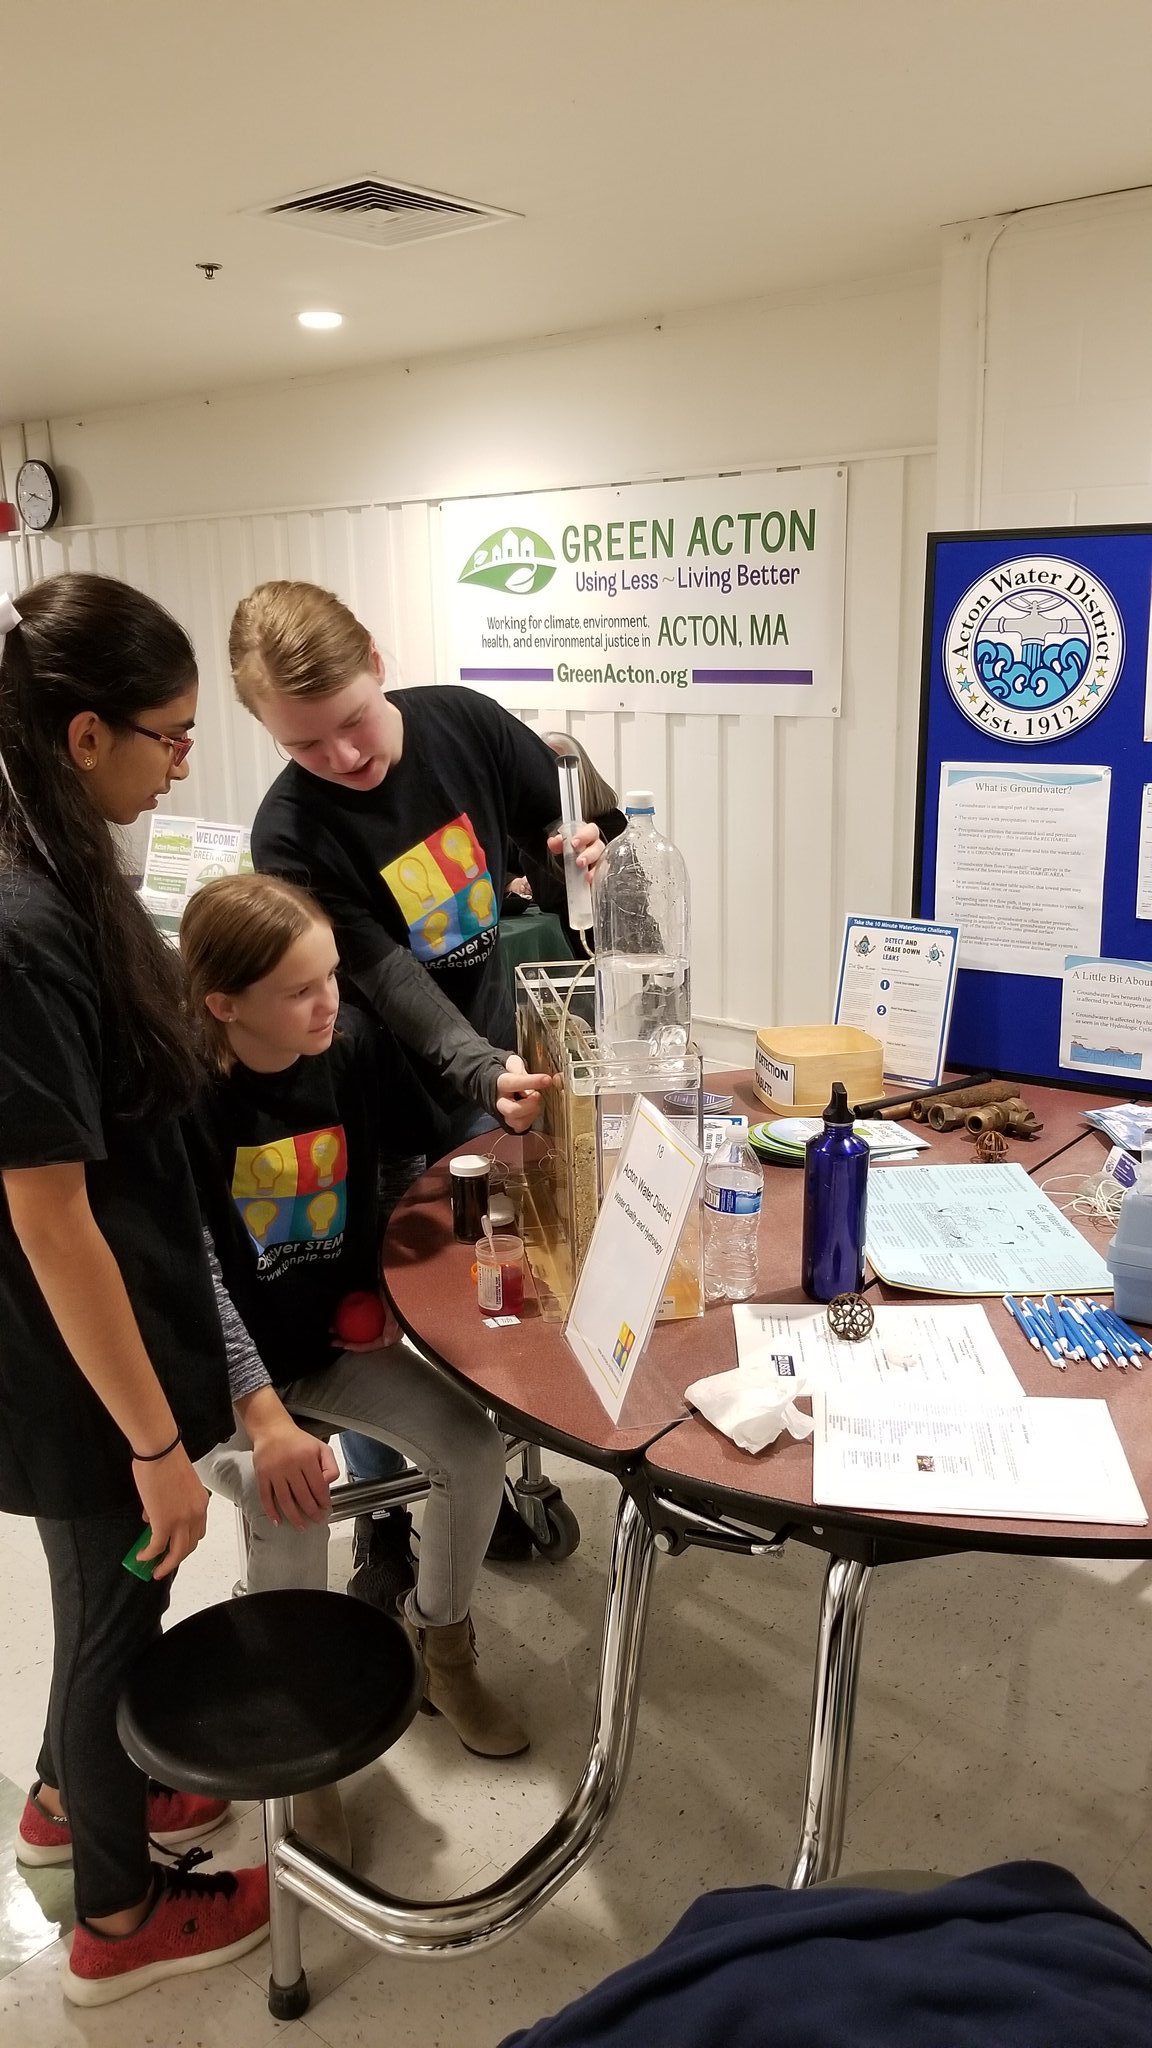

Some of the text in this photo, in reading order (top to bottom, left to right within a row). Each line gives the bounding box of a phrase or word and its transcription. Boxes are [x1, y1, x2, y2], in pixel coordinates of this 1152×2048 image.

[562, 508, 816, 563] GREEN ACTON
[576, 570, 617, 597] Using
[621, 569, 658, 590] Less
[678, 566, 731, 594] Living
[737, 563, 800, 586] Better
[487, 614, 649, 630] Working for climate, environment,
[952, 568, 1115, 664] Acton Water District
[482, 633, 650, 651] health, and environmental justice in
[658, 614, 789, 648] ACTON, MA
[557, 663, 687, 688] GreenActon.org
[975, 700, 1079, 736] Est. 1912
[976, 783, 1072, 795] What is Groundwater?
[197, 832, 238, 846] WELCOME!
[927, 927, 951, 935] Challenge
[1072, 971, 1079, 979] A
[1083, 972, 1106, 981] Little
[1109, 974, 1122, 983] Bit
[759, 1053, 788, 1081] DETECTION
[756, 1072, 772, 1097] TABLETS
[656, 1144, 664, 1159] 18
[623, 1163, 673, 1224] Acton Water District
[614, 1191, 663, 1255] Water Quality and Hydrology
